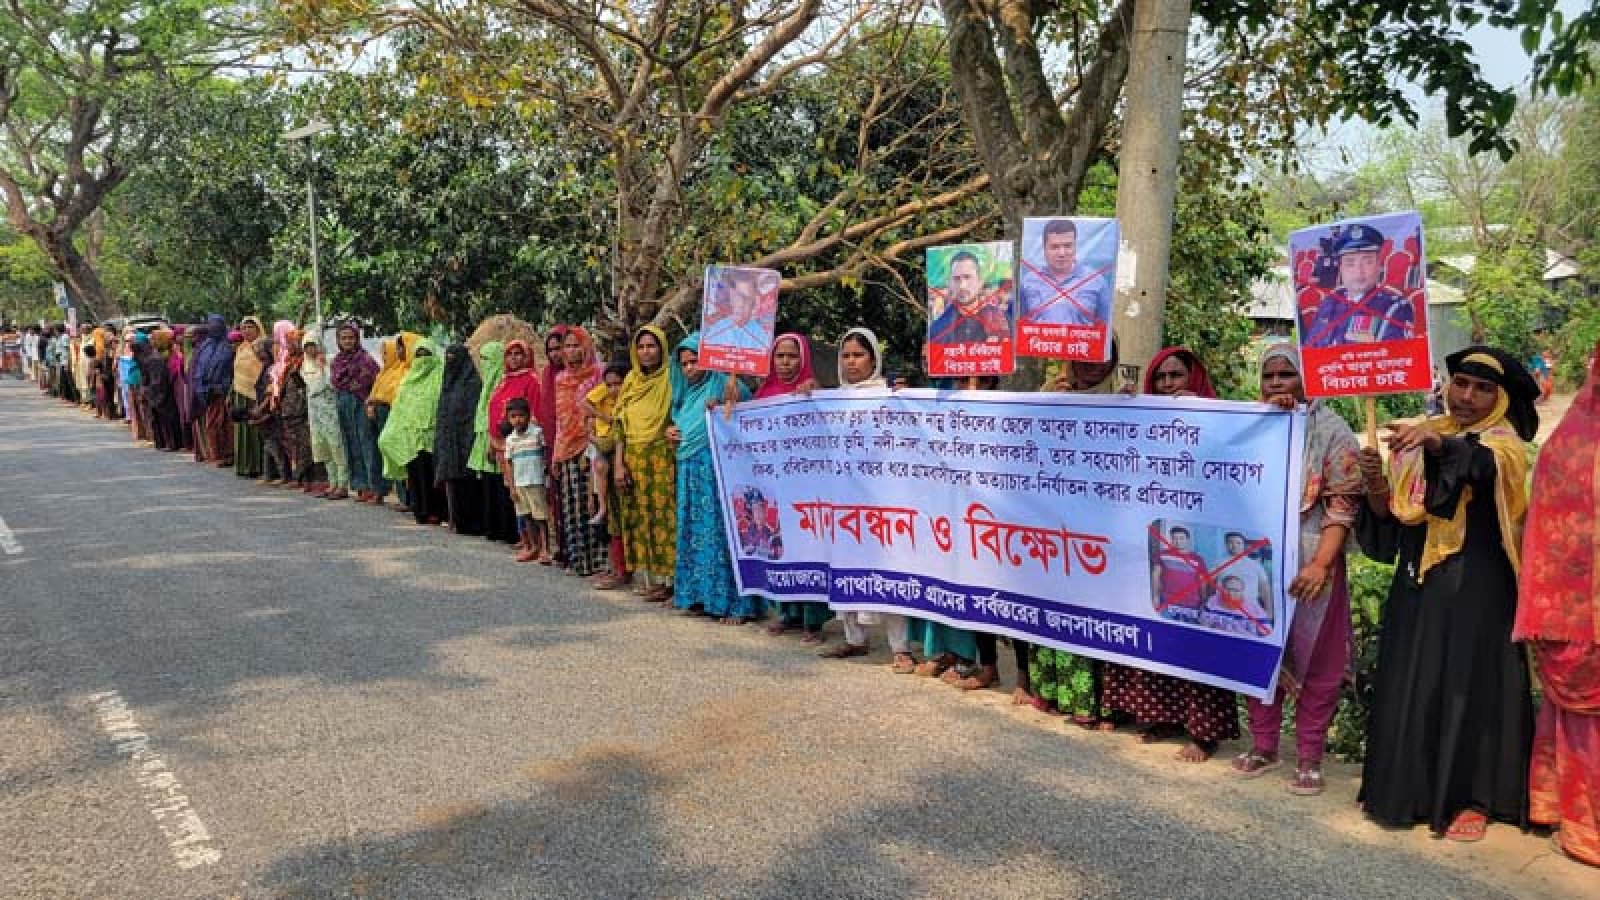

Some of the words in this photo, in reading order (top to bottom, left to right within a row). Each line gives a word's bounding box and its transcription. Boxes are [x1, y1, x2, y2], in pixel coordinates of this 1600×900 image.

[1067, 341, 1088, 357] চাই
[1322, 375, 1369, 391] বিচার
[1376, 371, 1408, 387] চাই
[949, 408, 995, 433] উকিলের
[1001, 417, 1032, 437] ছেলে
[1037, 419, 1078, 440] আবুল
[1082, 421, 1140, 441] হাসনাত
[1145, 418, 1201, 446] এসপির
[1047, 448, 1077, 466] তার
[1081, 445, 1141, 473] সহযোগী
[1146, 452, 1197, 478] সন্ত্রাসী
[1201, 460, 1265, 486] সোহাগ
[1092, 481, 1131, 502] করার
[1136, 481, 1204, 513] প্রতিবাদে
[930, 515, 953, 552] ও
[963, 502, 1111, 577] বিক্ষোভ
[924, 585, 967, 614] গ্রামের
[970, 590, 1041, 627] সর্বস্তরের
